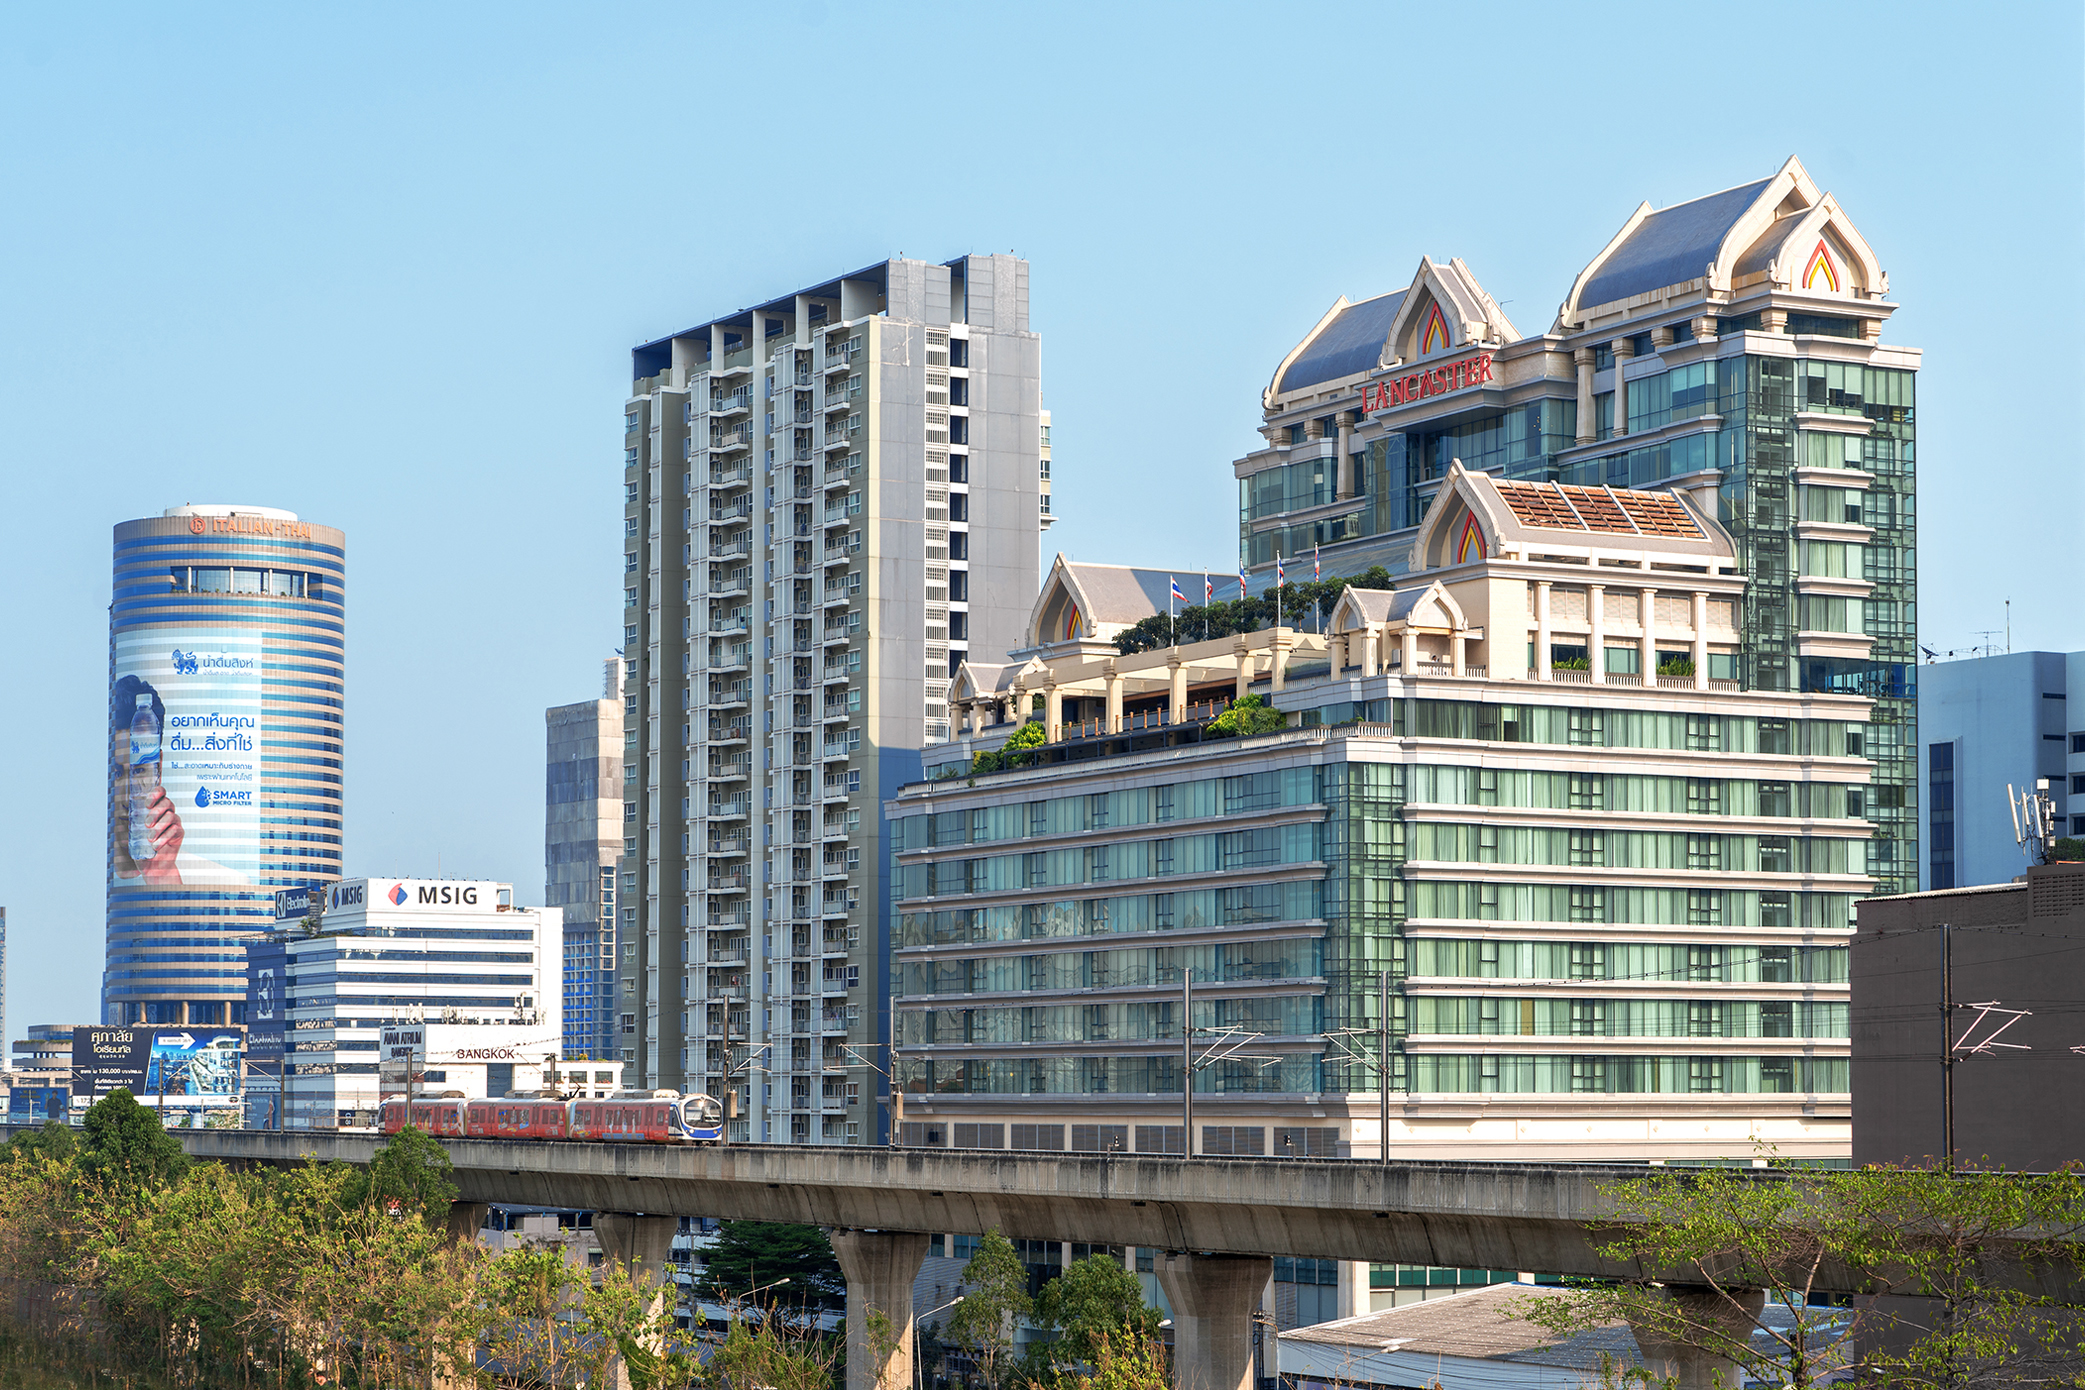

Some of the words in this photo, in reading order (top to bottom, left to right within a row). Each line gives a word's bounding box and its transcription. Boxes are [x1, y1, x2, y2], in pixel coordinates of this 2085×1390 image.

[1361, 354, 1494, 414] LANCASTER
[202, 655, 254, 668] น้ำดื่มสิงห์
[171, 712, 255, 731] อยากเห็นคุณ
[213, 790, 252, 800] SMART
[341, 885, 363, 906] MSIG
[418, 886, 477, 905] MSIG
[91, 1029, 133, 1045] ศุภาลัย
[457, 1048, 515, 1059] BANGKOK
